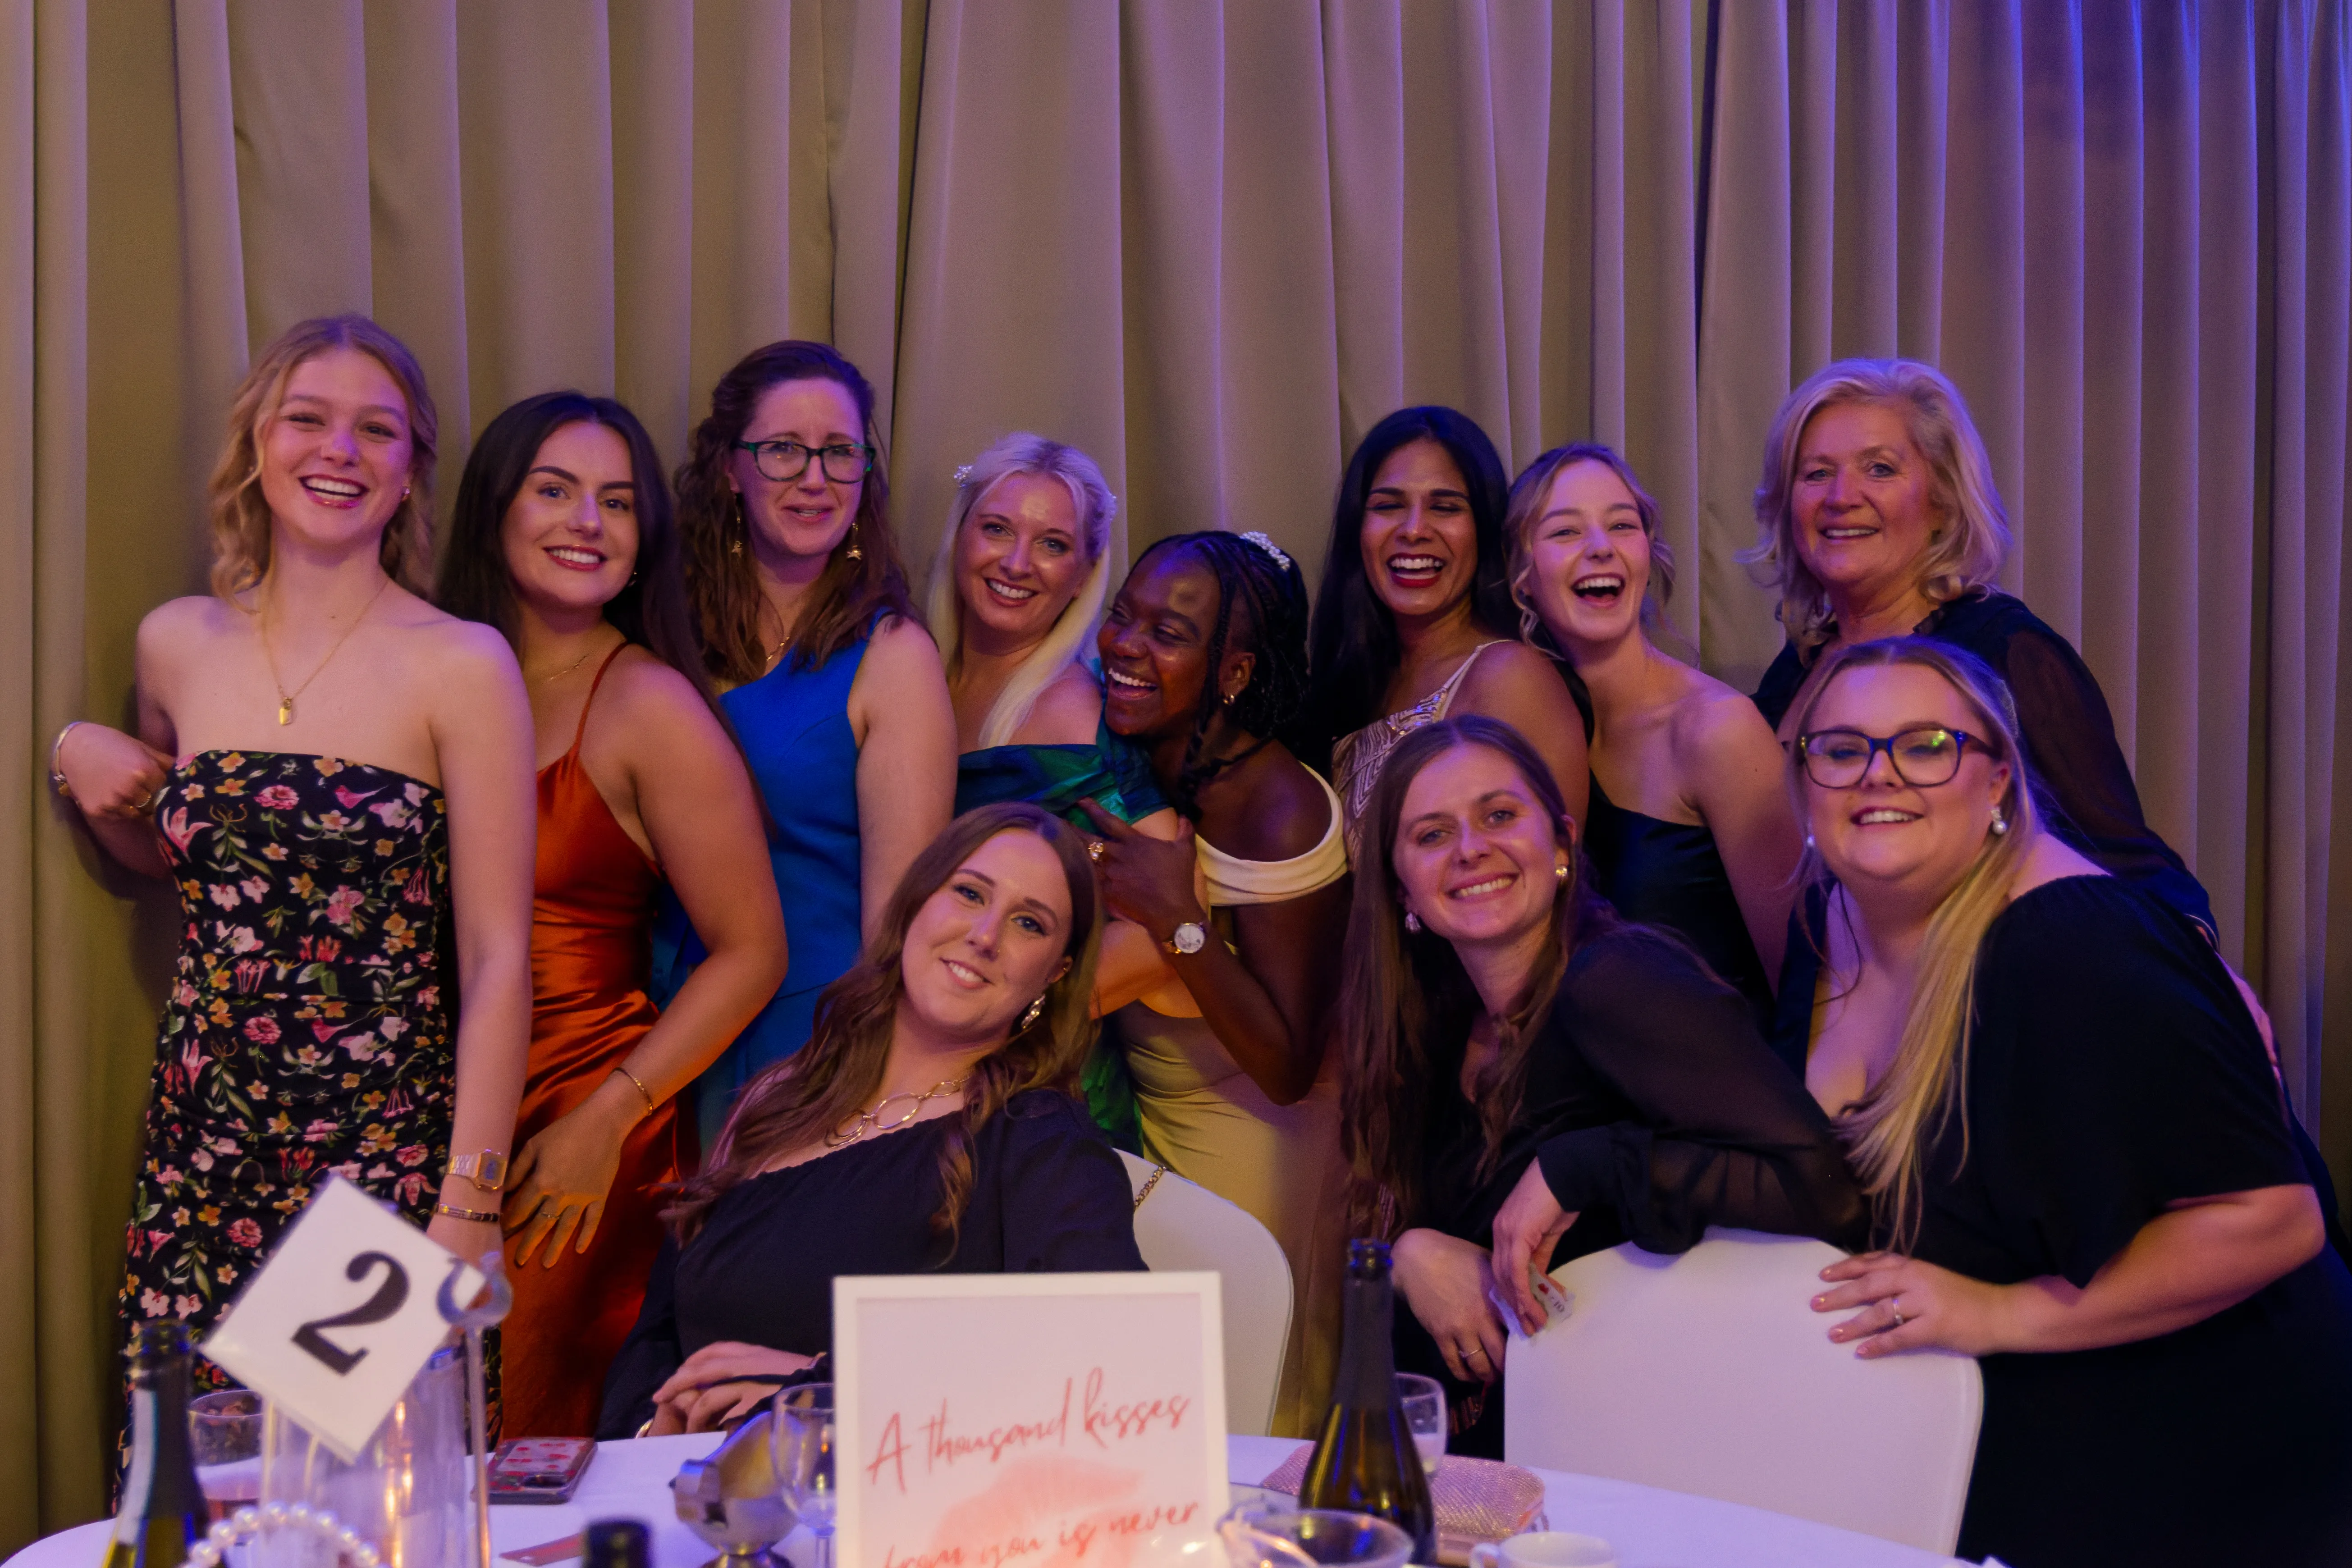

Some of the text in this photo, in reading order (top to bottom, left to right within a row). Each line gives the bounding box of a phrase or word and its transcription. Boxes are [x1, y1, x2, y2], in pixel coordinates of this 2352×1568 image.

[291, 1251, 409, 1376] 2
[866, 1366, 1191, 1494] A thousand kisses
[980, 1537, 1045, 1568] you
[1059, 1519, 1097, 1558] is
[1107, 1500, 1199, 1535] never
